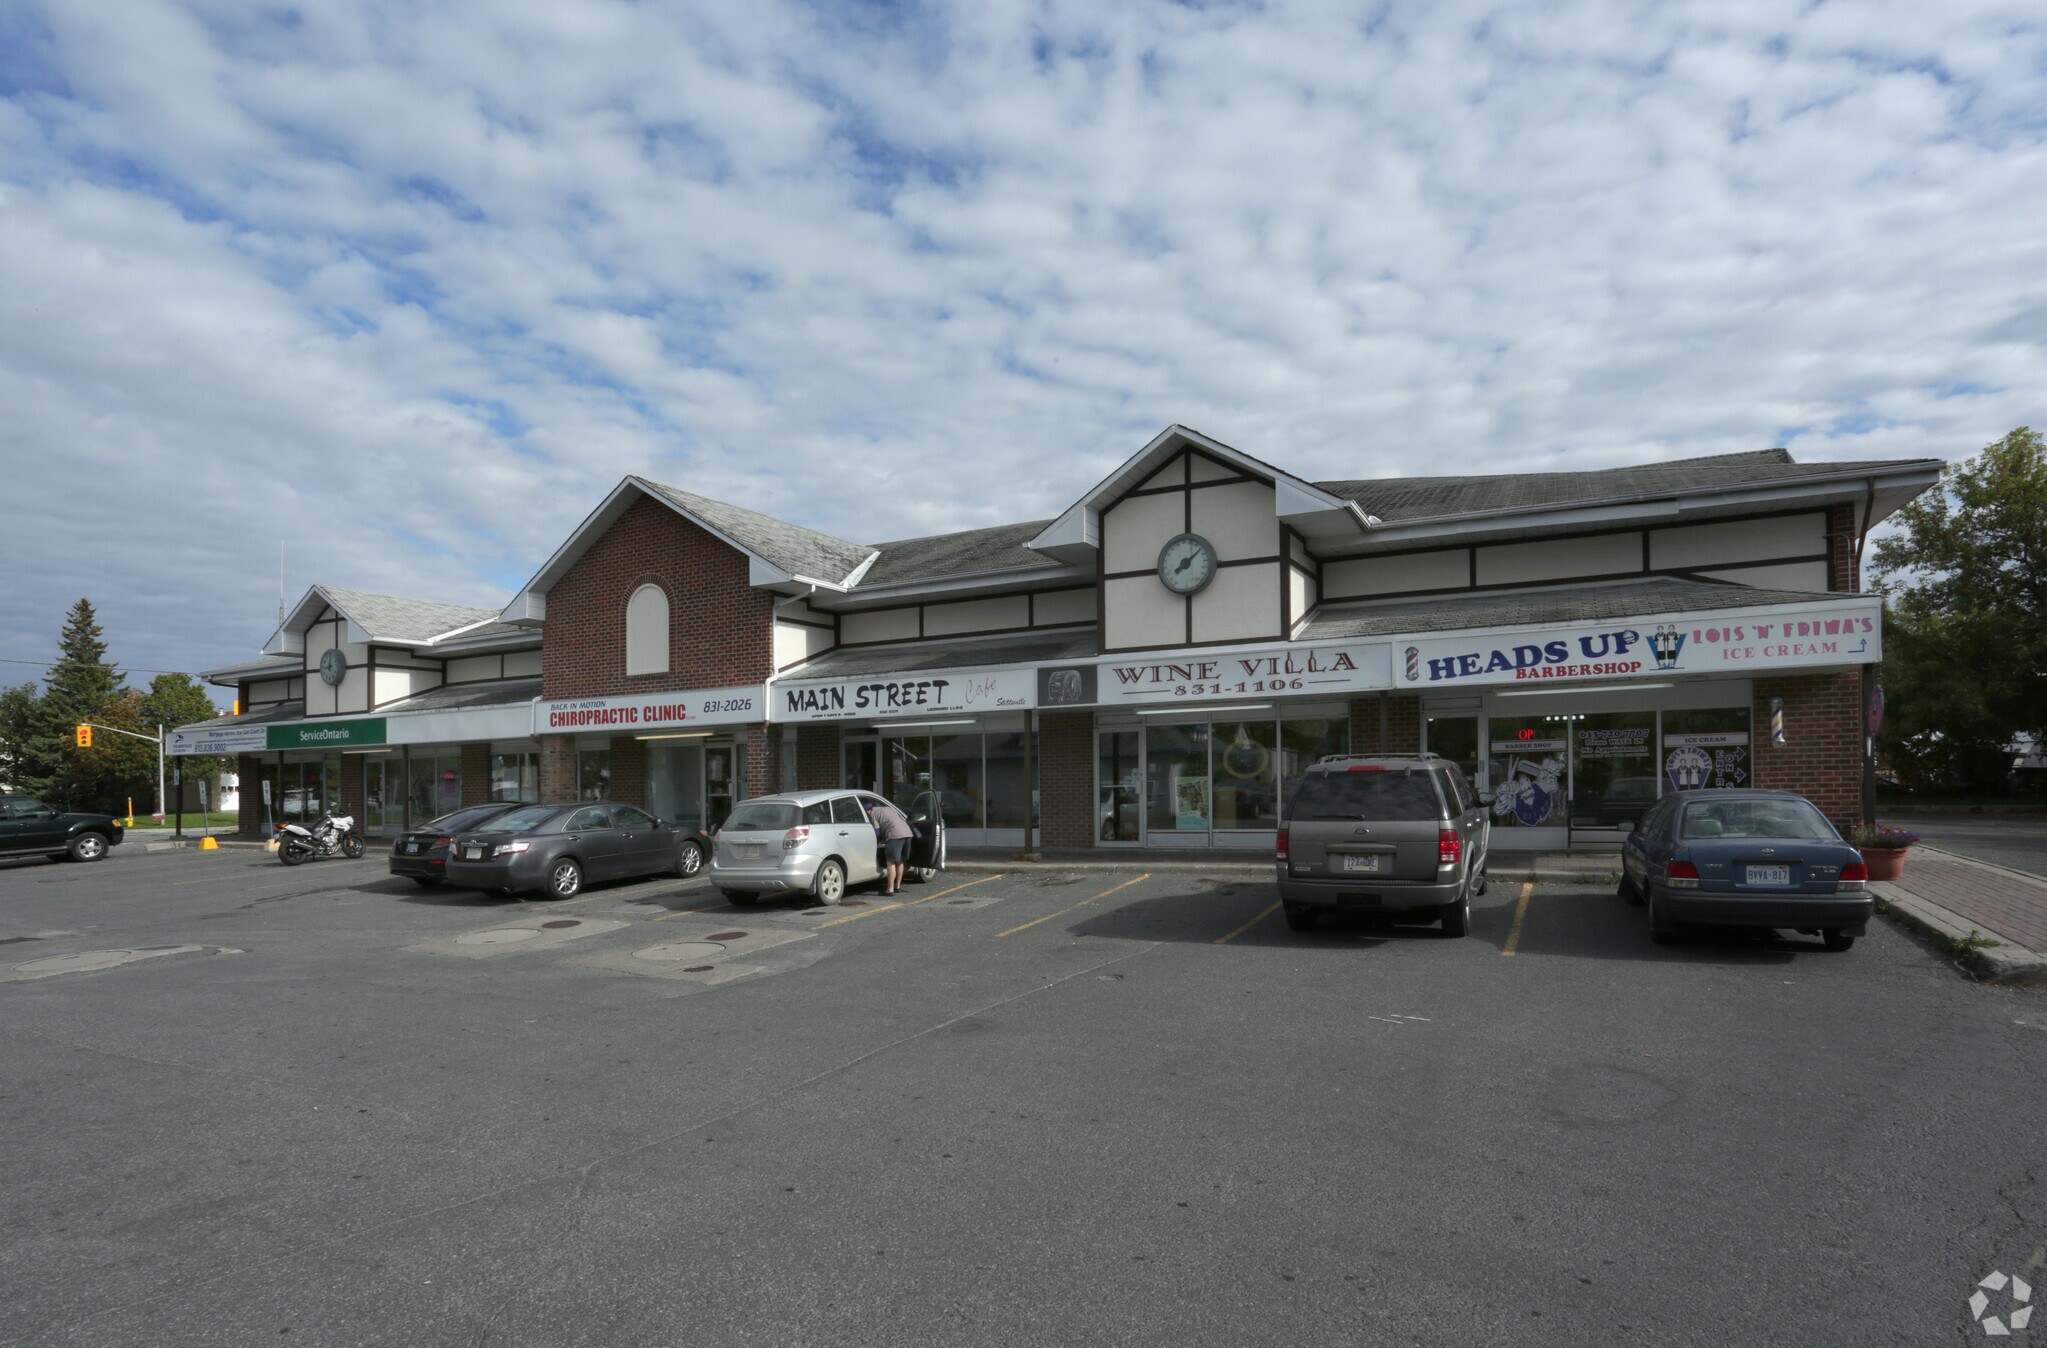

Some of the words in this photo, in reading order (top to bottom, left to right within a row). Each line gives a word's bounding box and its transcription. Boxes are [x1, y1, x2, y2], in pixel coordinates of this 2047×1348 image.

[1692, 626, 1744, 644] LOIS
[1427, 640, 1569, 681] HEADS
[1578, 629, 1640, 658] UP
[1722, 646, 1755, 660] ICE
[1763, 641, 1838, 657] CREAM
[1112, 661, 1221, 685] WINE
[1238, 650, 1359, 677] VILLA
[1515, 661, 1642, 680] BARBERSHOP
[786, 685, 845, 713] MAIN
[855, 680, 950, 709] STREET
[965, 677, 997, 704] Cafe
[1174, 677, 1304, 697] 831-1106
[550, 703, 568, 711] BACK
[570, 702, 577, 710] IN
[579, 701, 606, 709] MOTION
[550, 706, 638, 727] CHIROPRACTIC
[643, 703, 686, 722] CLINIC
[703, 698, 752, 713] 831-2026
[300, 728, 350, 741] ServiceOntario
